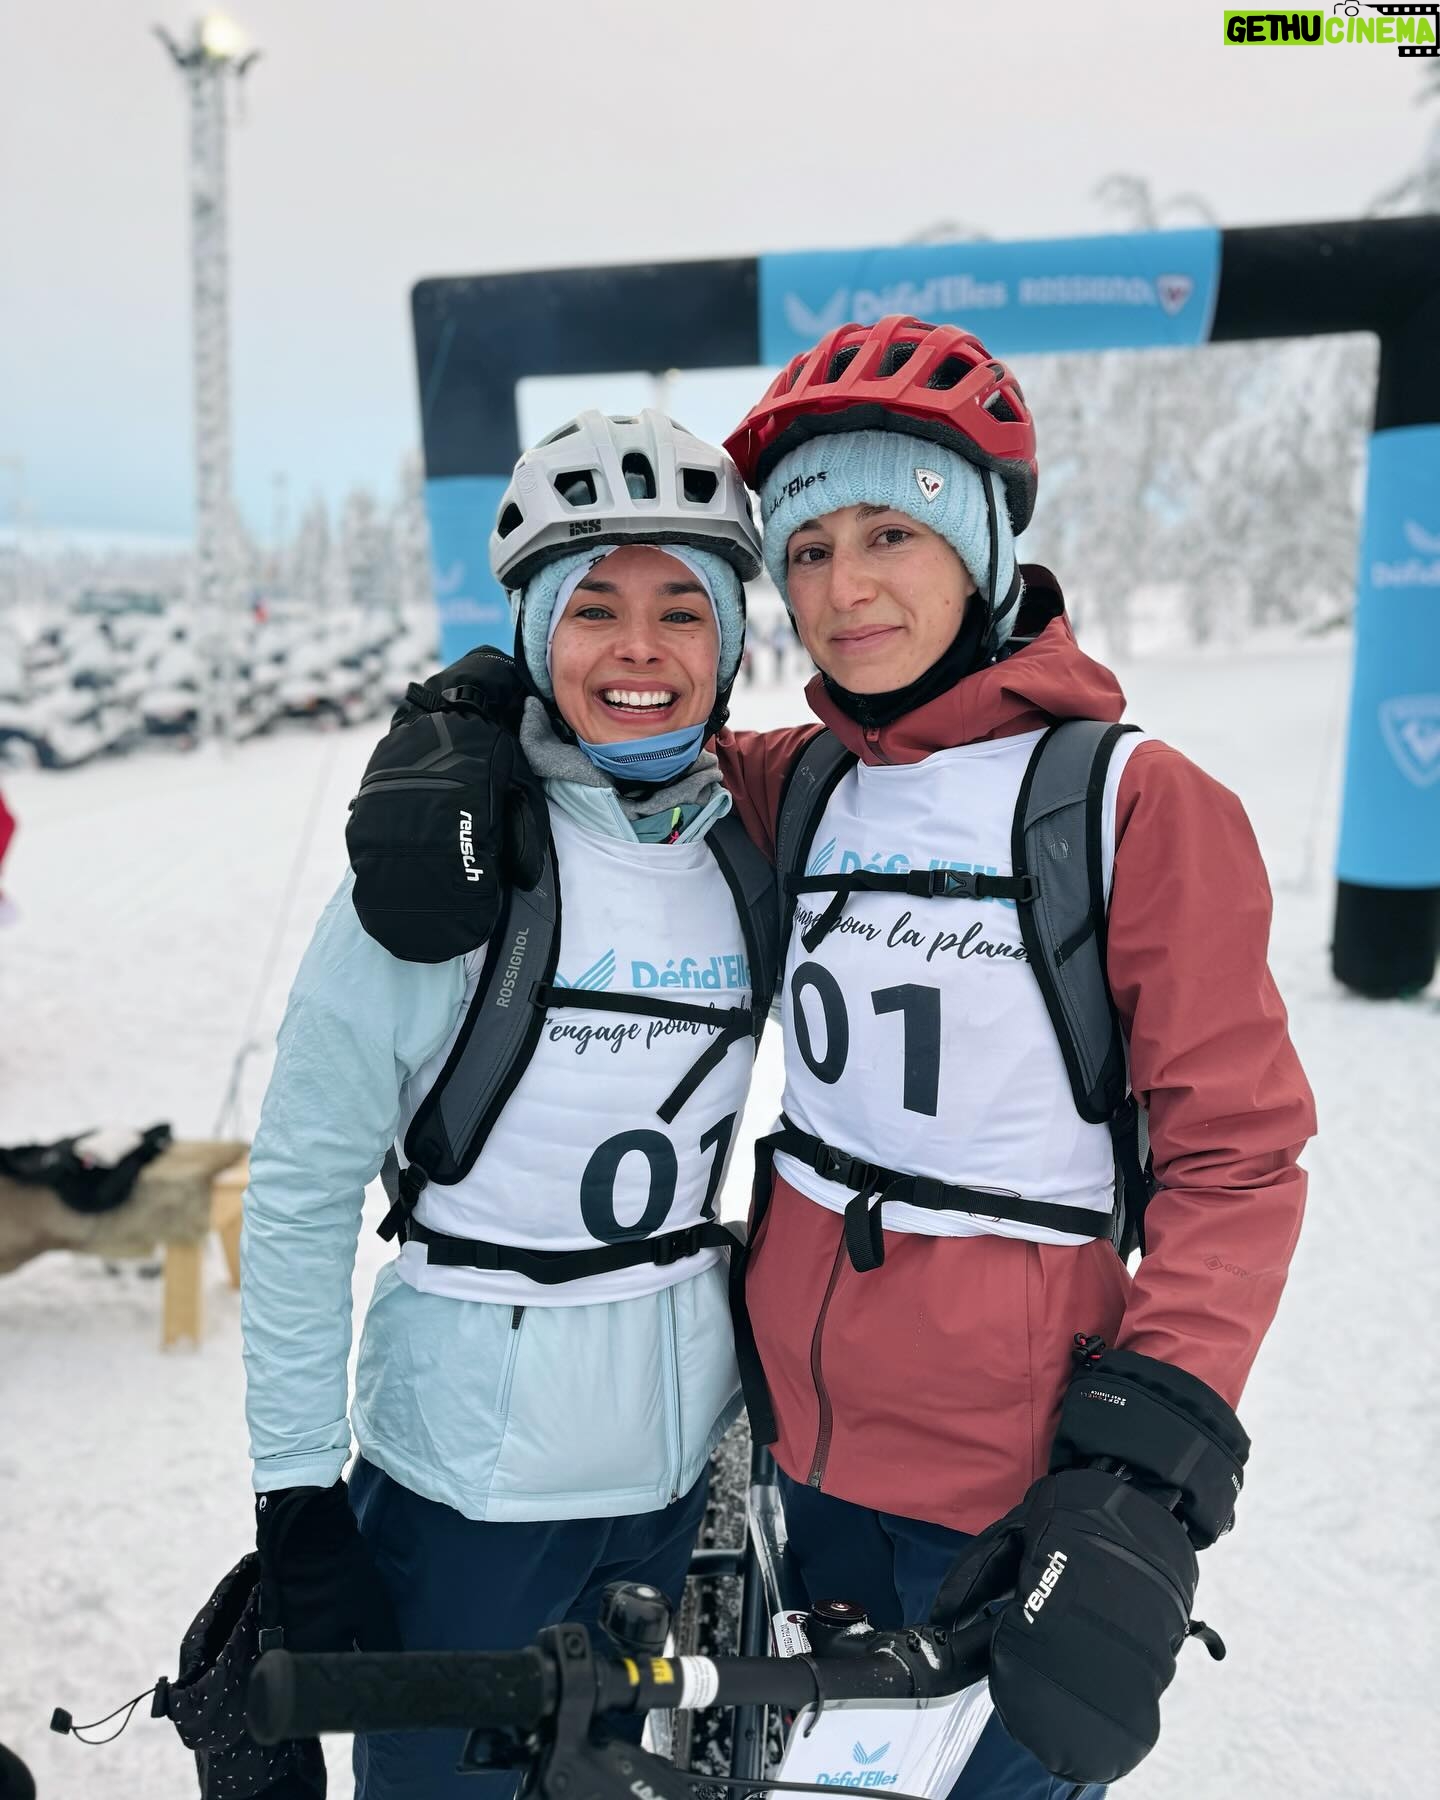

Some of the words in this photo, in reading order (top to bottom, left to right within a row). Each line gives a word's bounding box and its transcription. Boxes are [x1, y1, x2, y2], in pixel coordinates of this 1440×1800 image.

[459, 809, 484, 882] reusch
[496, 927, 530, 1009] ROSSIGNOL
[887, 911, 926, 948] la
[791, 961, 941, 1117] 01
[580, 1110, 738, 1244] 01
[1023, 1550, 1068, 1624] reusch
